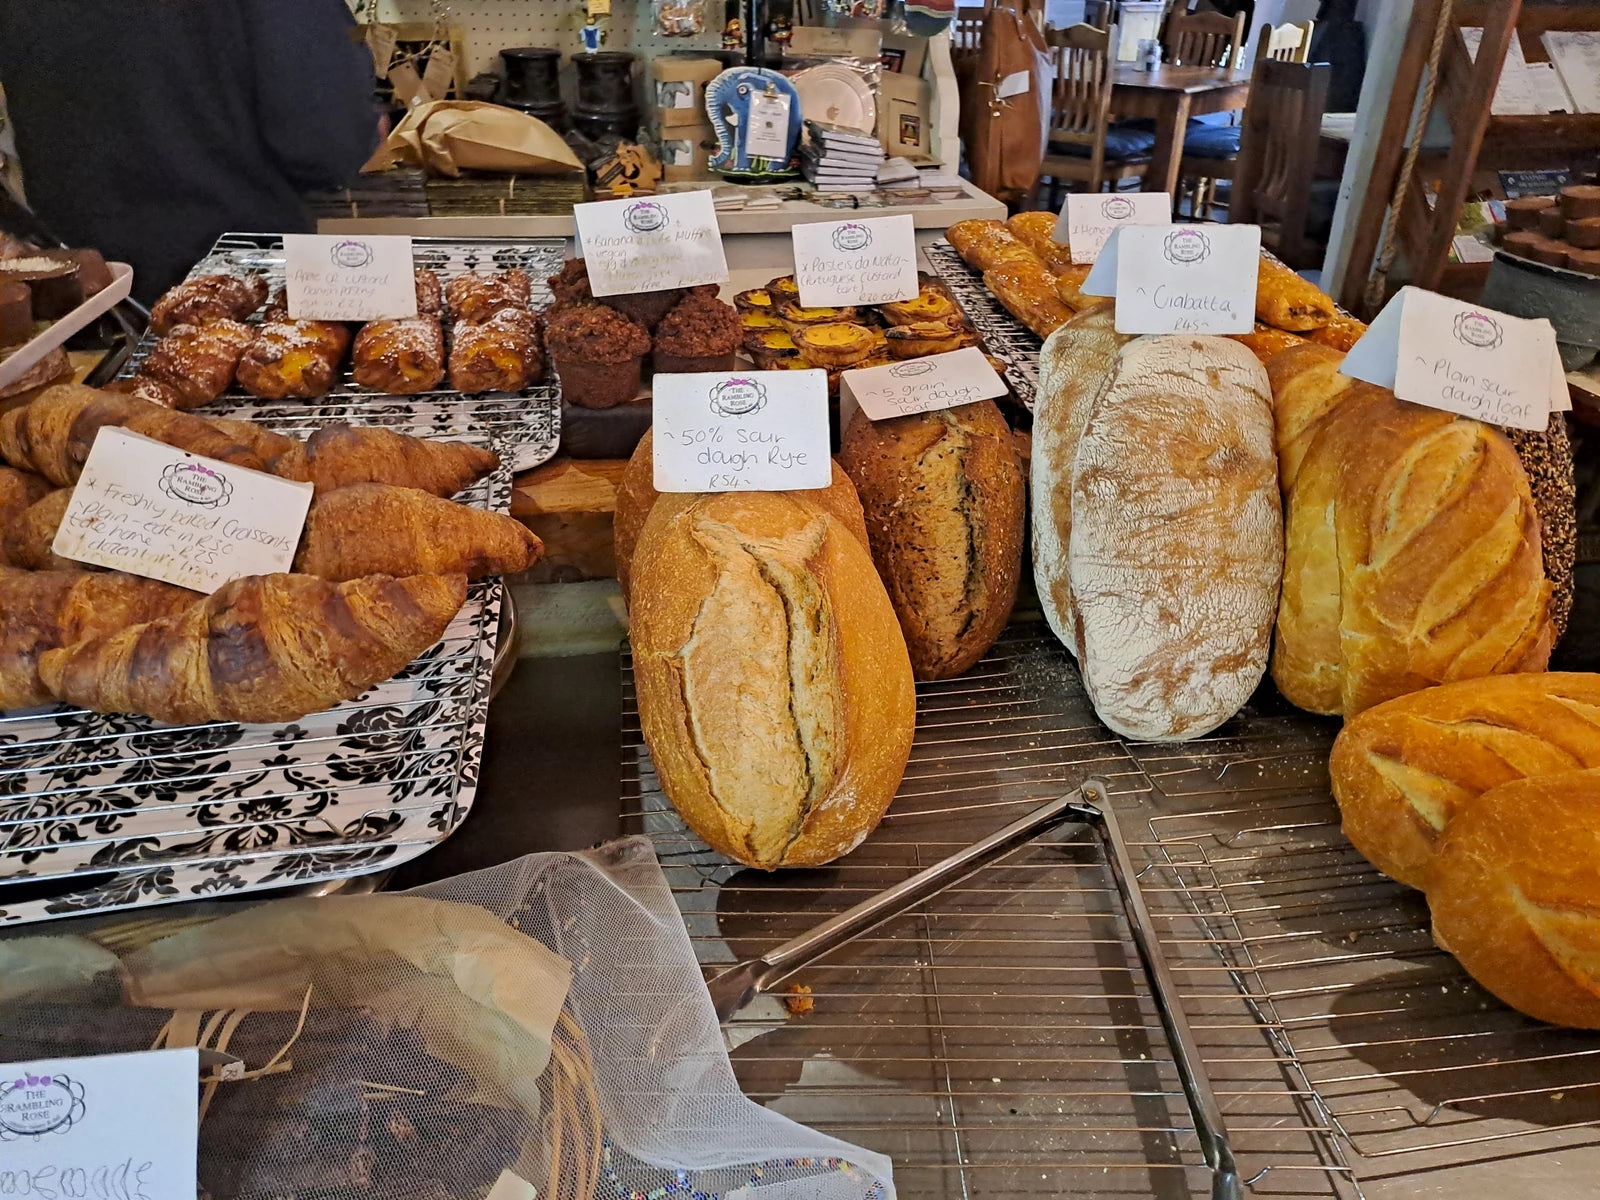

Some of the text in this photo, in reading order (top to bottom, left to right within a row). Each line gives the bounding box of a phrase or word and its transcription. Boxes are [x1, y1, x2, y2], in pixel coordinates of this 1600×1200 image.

[1153, 284, 1231, 311] Ciabatta
[1434, 358, 1476, 386] Plain
[682, 427, 723, 446] 50%
[768, 446, 807, 468] Rye
[193, 473, 207, 483] THE
[709, 474, 739, 488] R54
[104, 483, 167, 518] Freshly
[26, 1090, 46, 1100] THE
[7, 1099, 63, 1112] RAMBLING
[22, 1111, 49, 1121] ROSE
